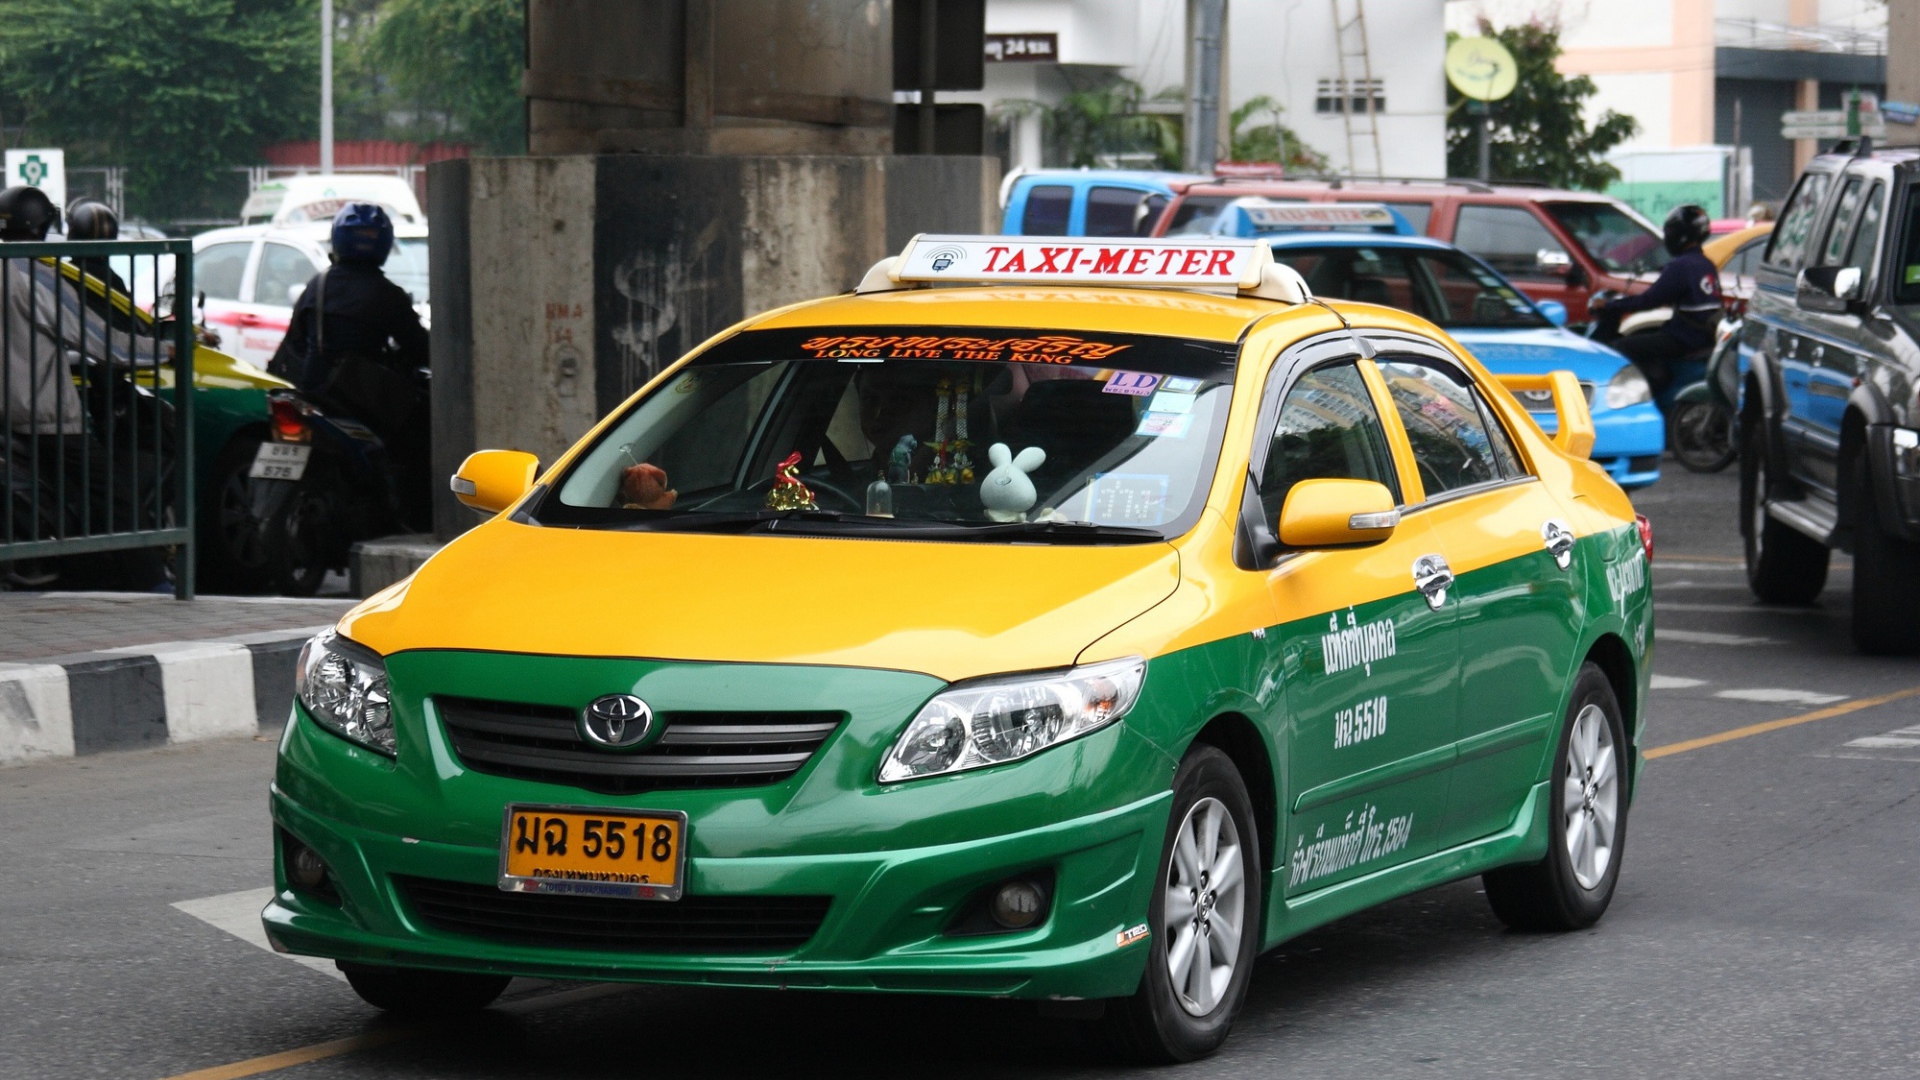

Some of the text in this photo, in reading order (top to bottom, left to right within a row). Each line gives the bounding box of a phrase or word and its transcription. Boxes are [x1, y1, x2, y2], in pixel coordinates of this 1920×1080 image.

[981, 246, 1237, 276] TAXI-METER
[813, 349, 1074, 365] LONG LIVE THE KING
[515, 815, 673, 863] มฉ 5518
[532, 868, 651, 884] กรงเทพมหานคร
[544, 882, 572, 892] TOYOTA
